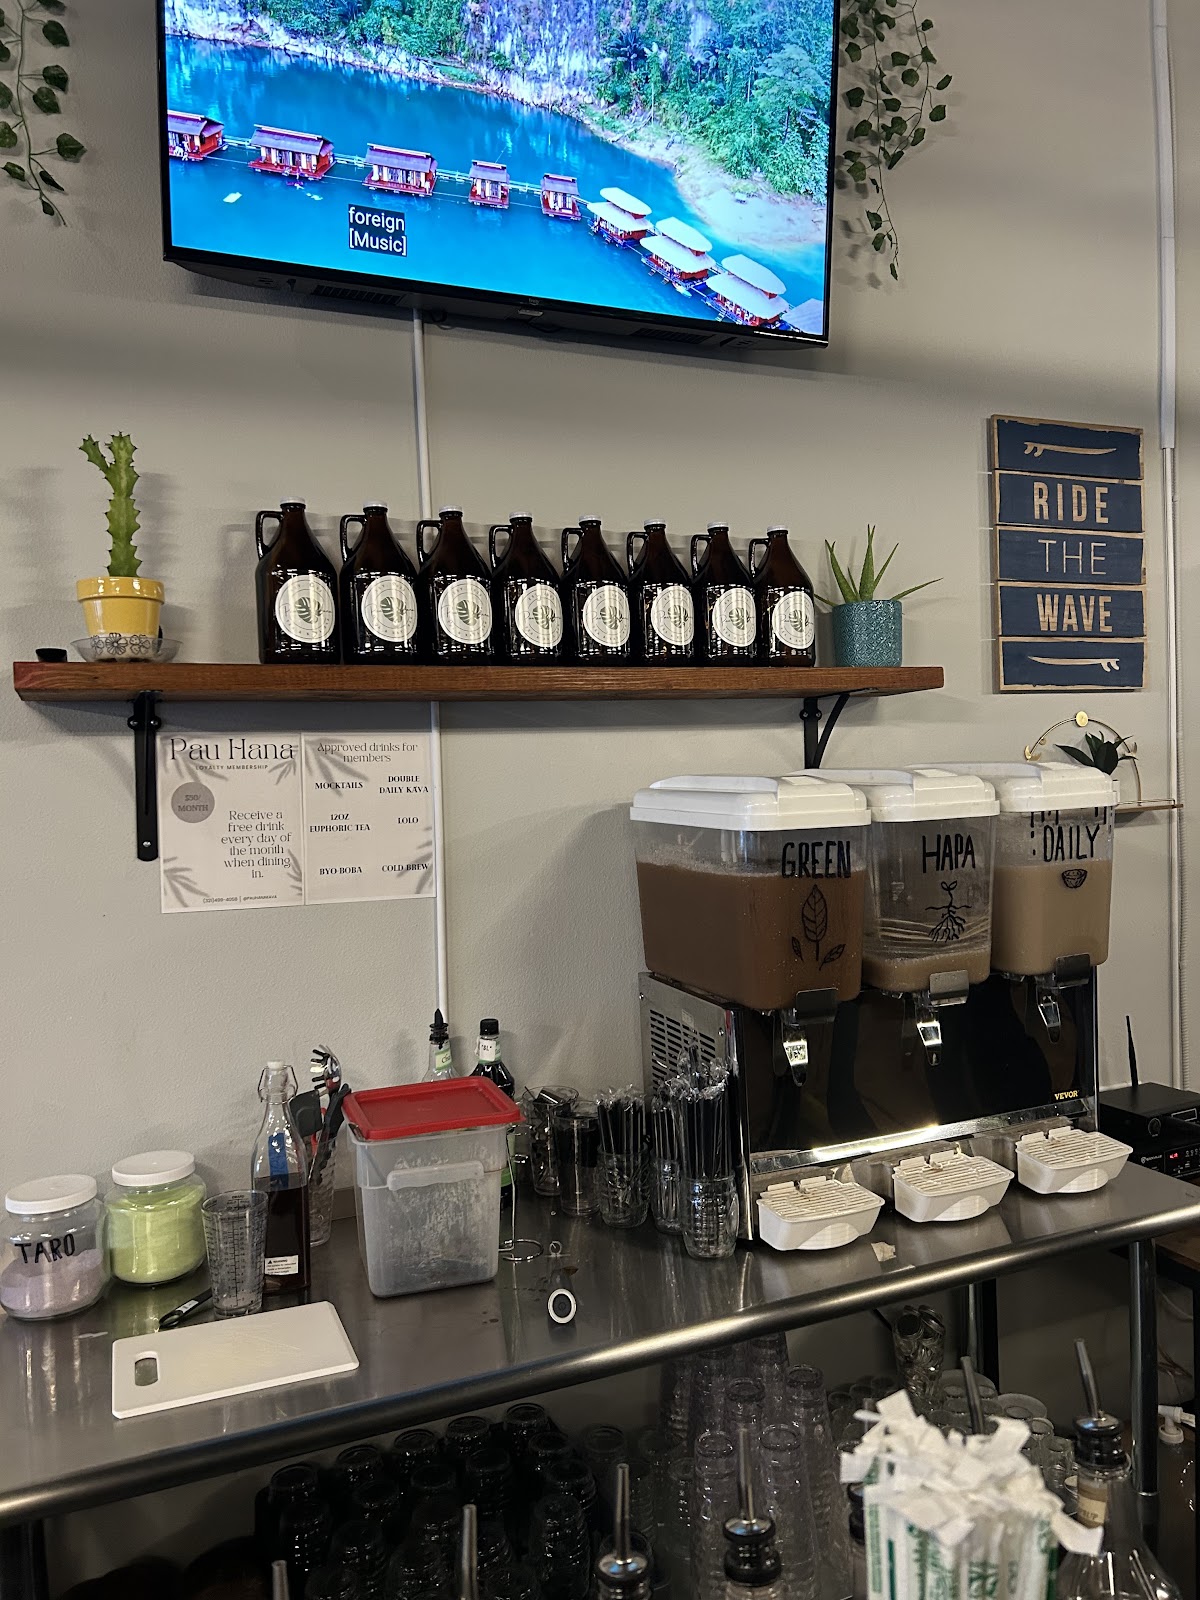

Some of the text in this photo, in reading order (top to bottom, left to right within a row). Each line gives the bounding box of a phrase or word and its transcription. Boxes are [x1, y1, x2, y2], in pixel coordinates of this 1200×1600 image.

[348, 206, 405, 233] foreign
[349, 228, 407, 256] [Music]
[1033, 481, 1109, 524] RIDE
[1037, 539, 1107, 575] THE
[1036, 593, 1113, 633] WAVE
[170, 738, 294, 761] Pau Hana
[317, 742, 418, 755] Approved drinks for
[343, 753, 392, 763] members
[388, 775, 420, 783] DOUBLE
[314, 781, 364, 790] MOCKTAILS
[379, 786, 404, 794] DAILY
[178, 804, 209, 812] MONTH
[229, 810, 283, 821] Receive a
[330, 813, 350, 821] 12OZ
[397, 817, 419, 825] LOLO
[228, 821, 285, 832] free drink
[309, 823, 371, 833] EUPHORIC TEA
[220, 832, 293, 847] every day of
[1043, 823, 1100, 863] DAILY
[229, 844, 285, 856] the month
[921, 833, 976, 874] HAPA
[224, 857, 291, 868] when dining
[781, 839, 852, 880] GREEN
[319, 866, 363, 875] BYO BOBA
[381, 863, 429, 872] COLD BREW
[251, 869, 264, 879] in.
[1054, 1090, 1078, 1100] VEVOR
[14, 1233, 76, 1263] TARO
